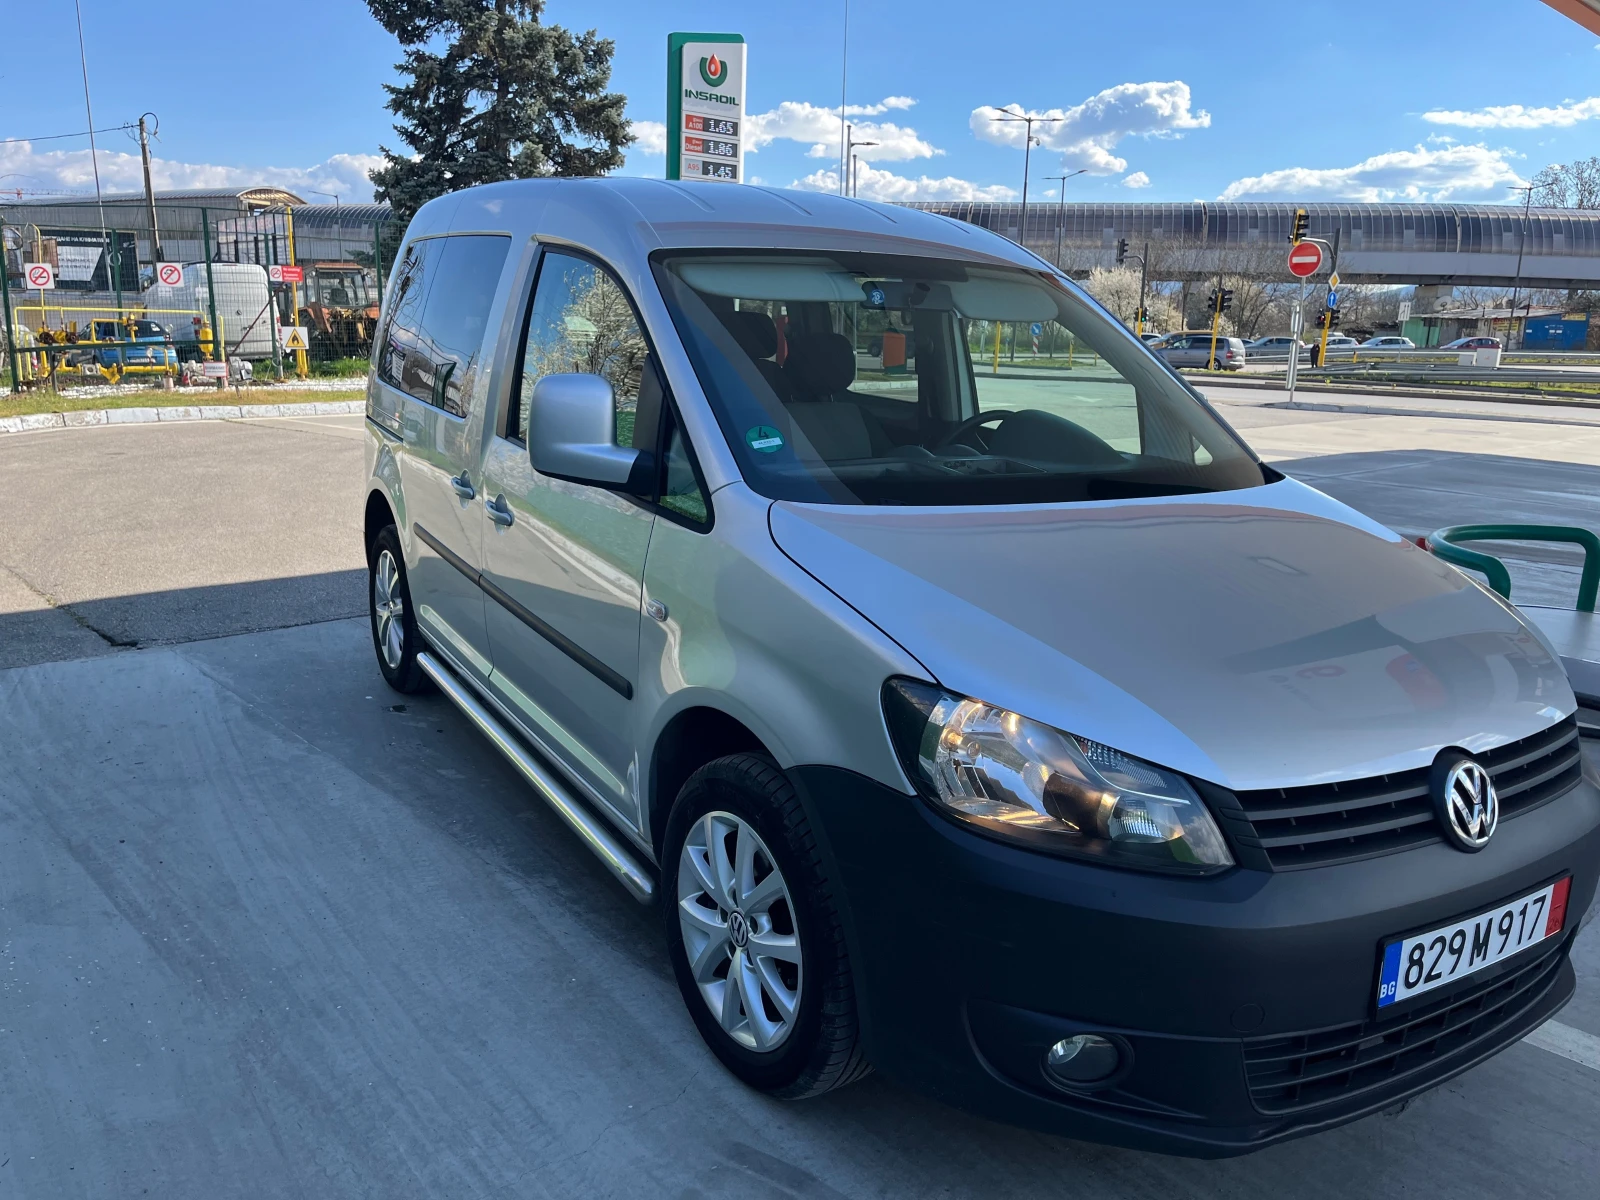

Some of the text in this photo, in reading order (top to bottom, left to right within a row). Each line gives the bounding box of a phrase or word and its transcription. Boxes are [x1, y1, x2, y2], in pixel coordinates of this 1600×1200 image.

[685, 89, 739, 105] INSAOIL
[688, 121, 702, 129] A100
[685, 143, 702, 151] Diesel
[708, 165, 732, 178] 1.45
[1380, 981, 1396, 999] BG
